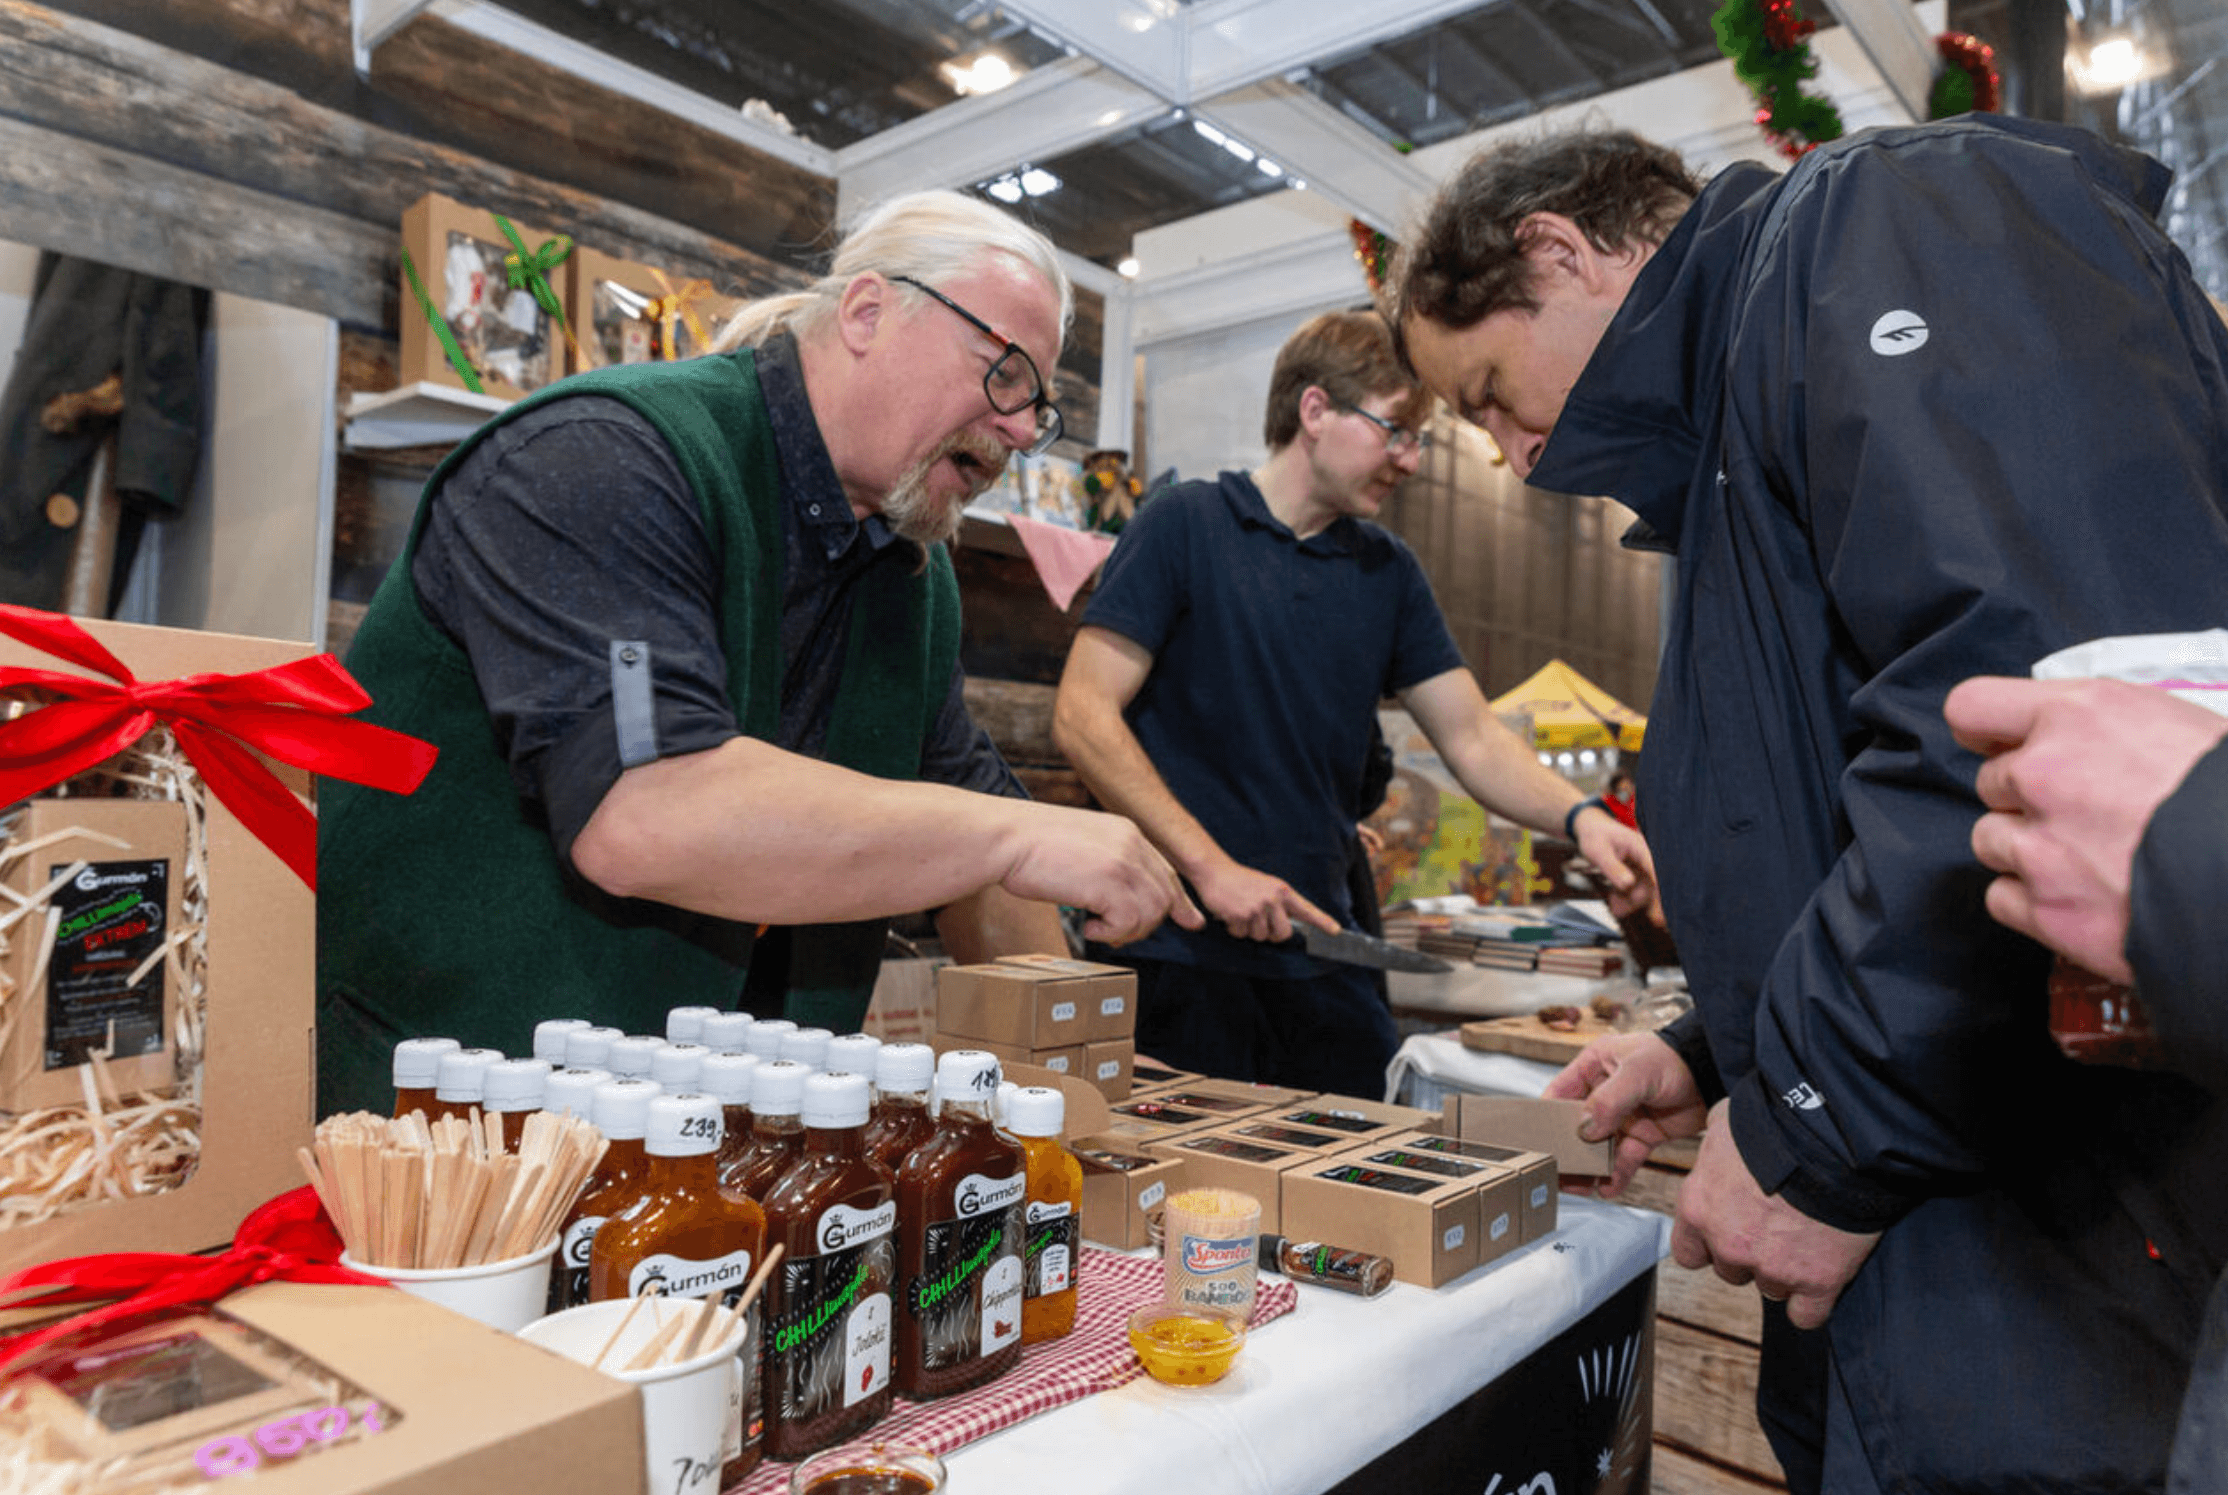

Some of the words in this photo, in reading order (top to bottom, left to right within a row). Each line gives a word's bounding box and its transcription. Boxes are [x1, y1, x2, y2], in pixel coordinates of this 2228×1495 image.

[959, 1182, 1022, 1215] Gurmán
[823, 1212, 892, 1249] Gurmán
[637, 1263, 742, 1297] Gurmán
